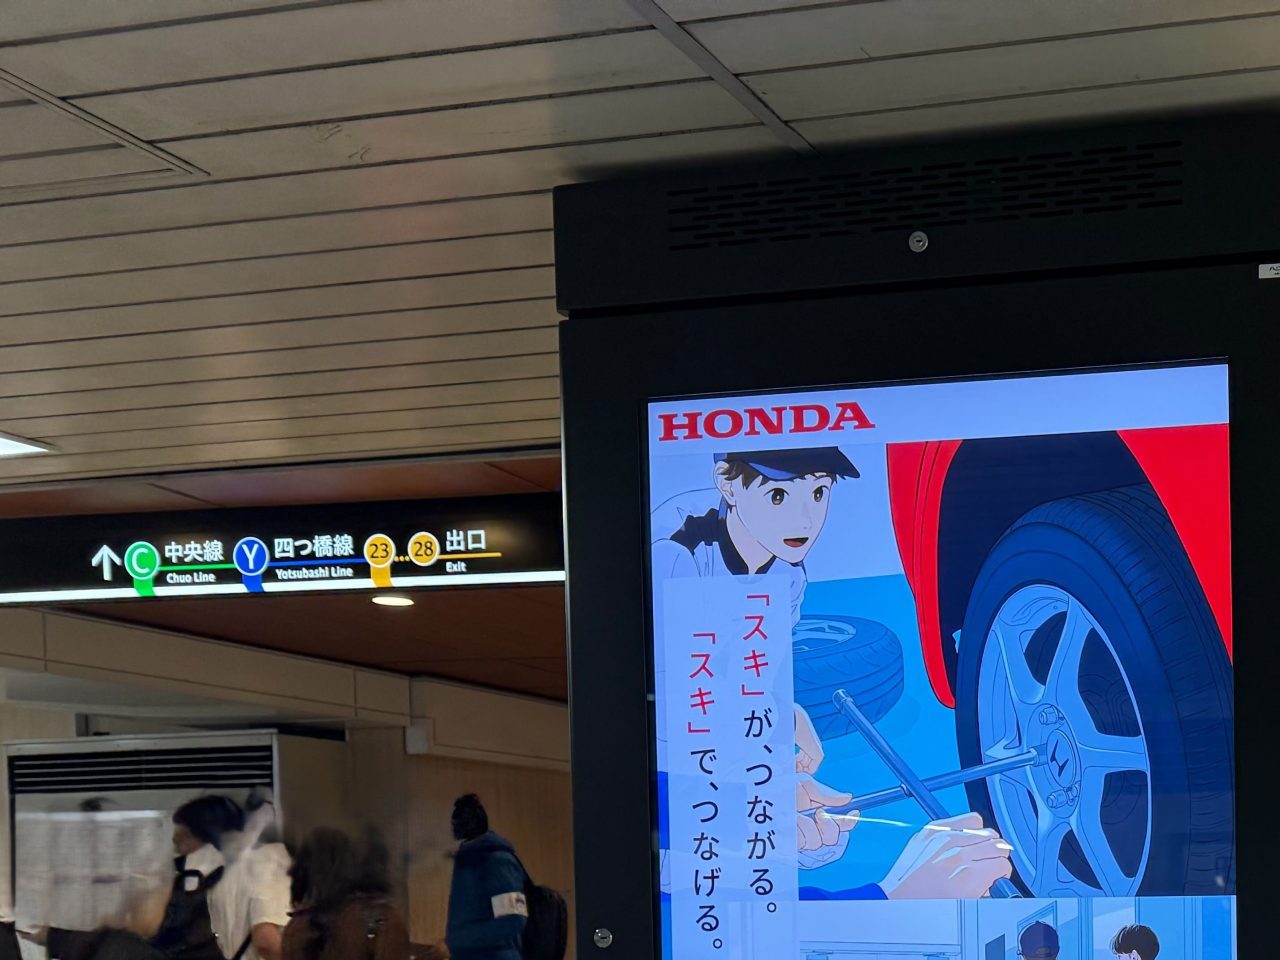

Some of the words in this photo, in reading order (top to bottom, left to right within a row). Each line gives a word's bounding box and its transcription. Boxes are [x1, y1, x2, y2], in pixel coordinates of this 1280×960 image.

[658, 402, 875, 441] HONDA
[131, 547, 150, 574] C
[164, 539, 224, 564] 中央線
[241, 543, 259, 570] Y
[274, 533, 355, 559] 四つ橋線
[369, 543, 389, 559] 23
[413, 541, 434, 557] 28
[445, 529, 486, 552] 出口
[166, 572, 192, 584] Chuo
[193, 571, 216, 583] Line
[275, 568, 328, 580] Yotsubashi
[330, 566, 354, 577] Line
[445, 561, 467, 572] Exit
[741, 593, 776, 914] 「スキ」が、つながる。
[687, 632, 723, 949] 「スキ」で、つなげる。
